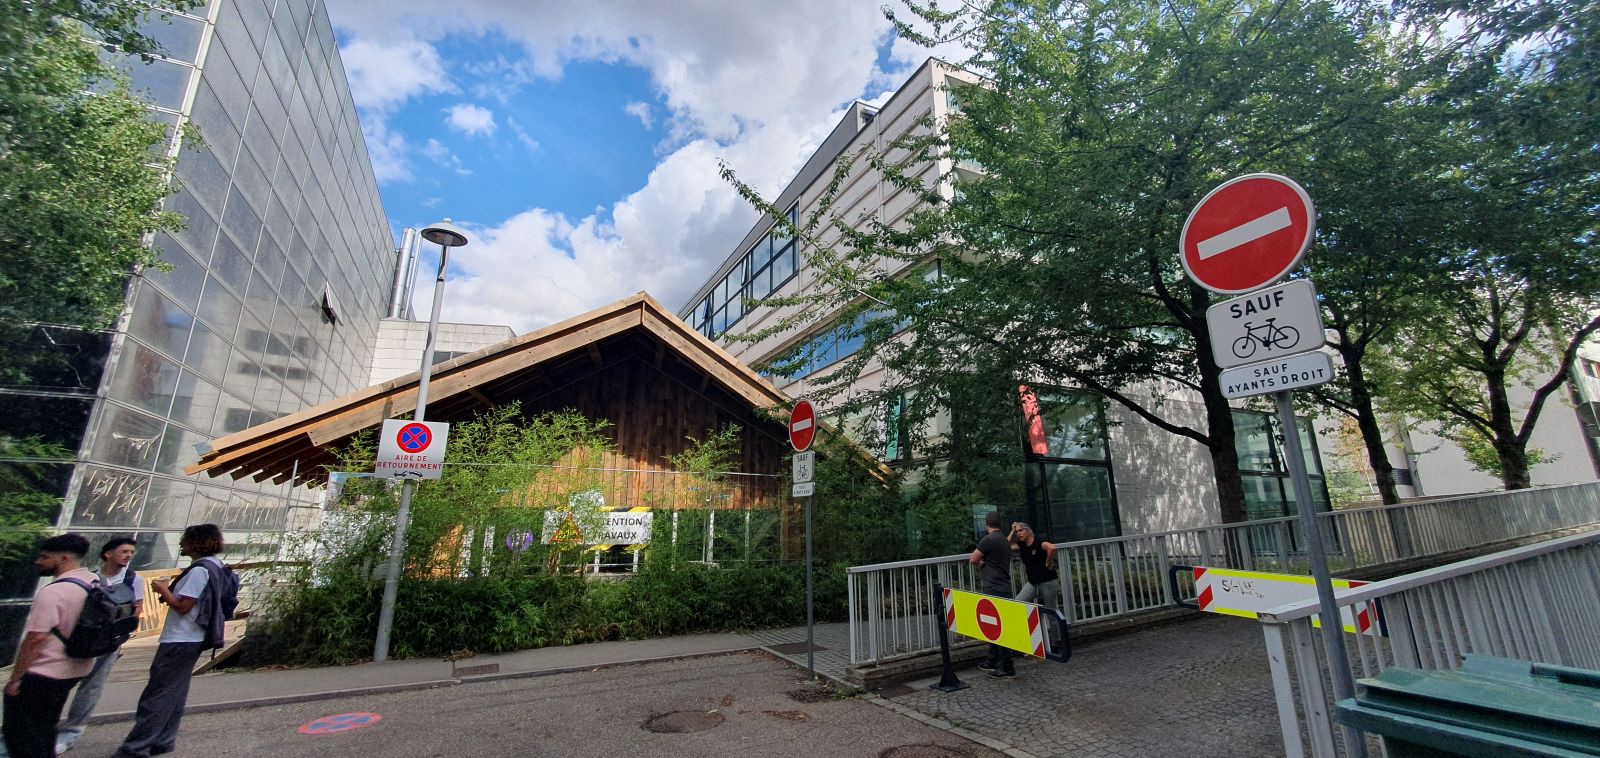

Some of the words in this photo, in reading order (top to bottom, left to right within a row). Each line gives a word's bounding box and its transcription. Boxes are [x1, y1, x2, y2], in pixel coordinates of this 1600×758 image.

[1230, 290, 1284, 319] SAUF
[1253, 363, 1288, 378] SAUF
[1228, 379, 1275, 394] AYANTS
[1281, 368, 1324, 384] DROIT
[395, 454, 414, 462] AIRE
[377, 461, 442, 470] RETOURNEMENT
[591, 517, 643, 527] TENTION
[594, 531, 637, 540] AVAUX
